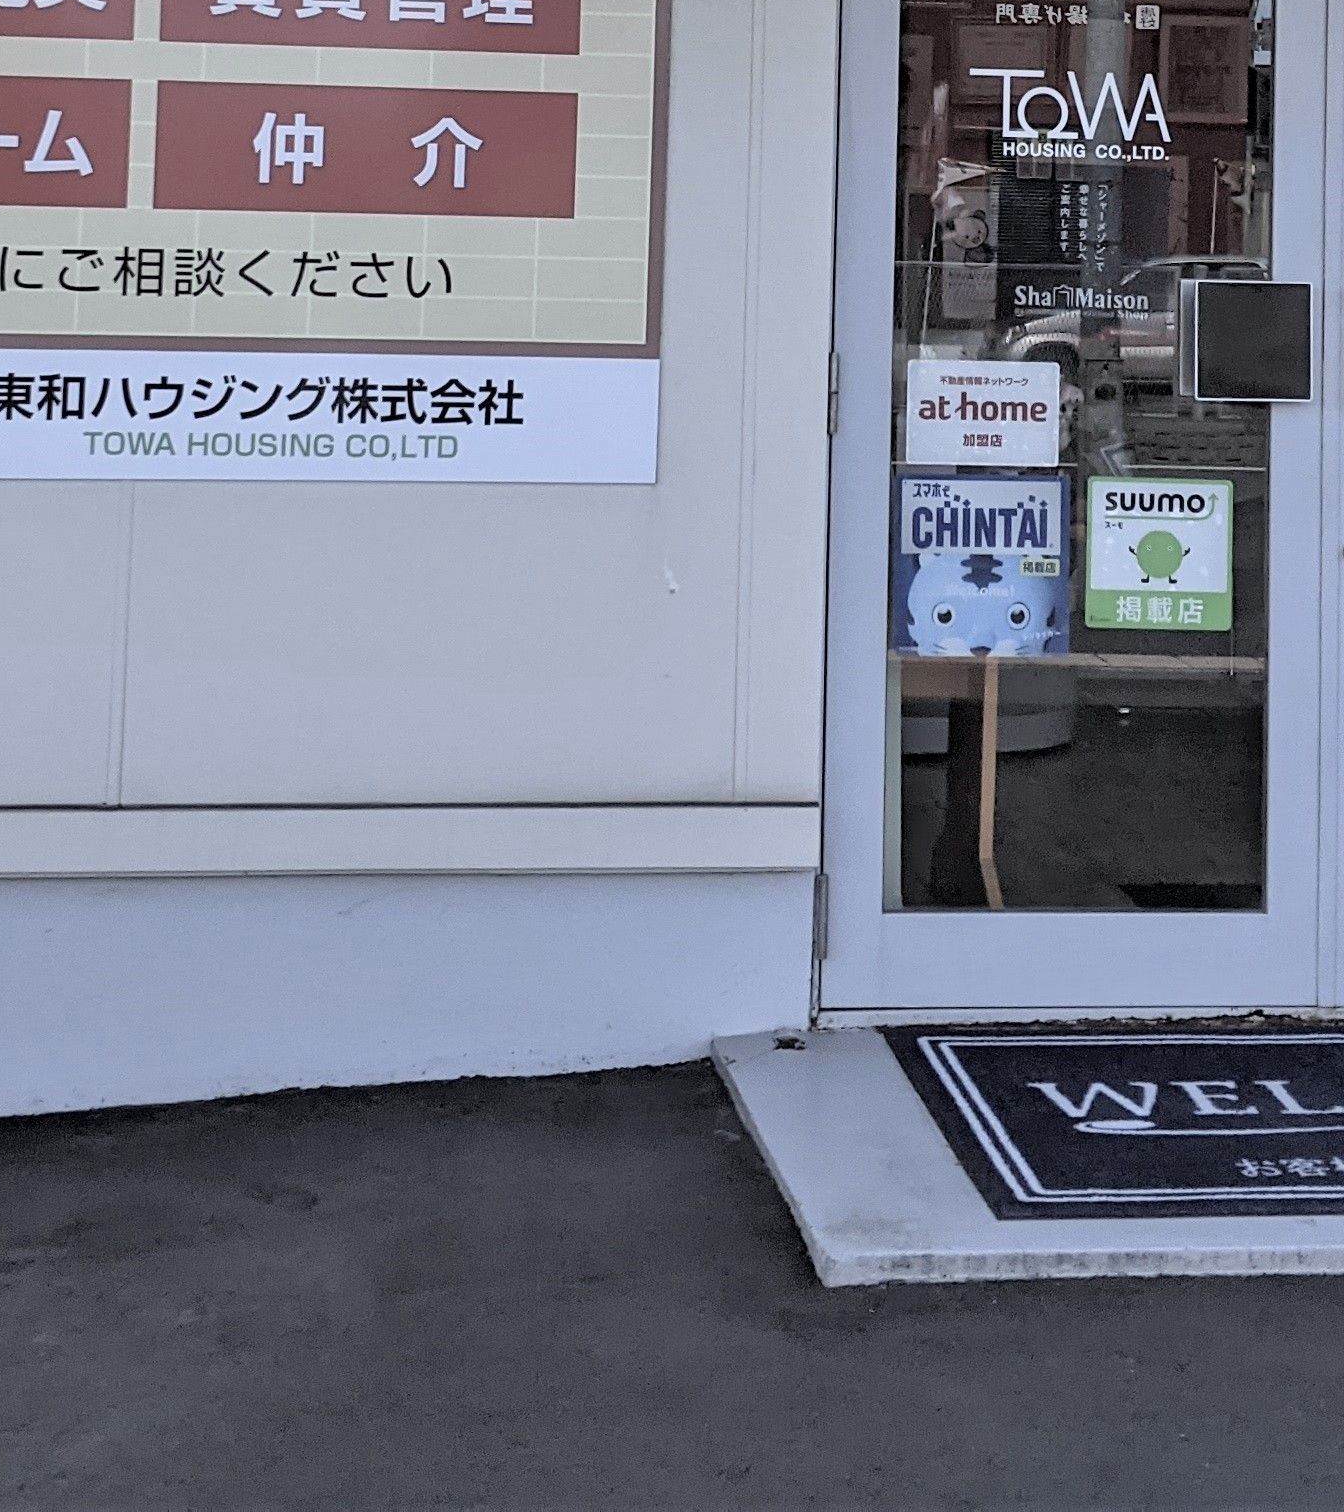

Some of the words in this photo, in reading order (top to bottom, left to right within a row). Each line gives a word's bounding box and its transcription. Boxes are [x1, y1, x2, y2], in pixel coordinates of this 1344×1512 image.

[1003, 142, 1086, 159] HOUSING
[1095, 144, 1170, 163] CO.,LTD.
[918, 395, 951, 421] at
[954, 391, 1048, 423] home
[83, 431, 177, 459] TOWA
[186, 433, 335, 461] HOUSING
[962, 433, 1003, 448] 加盟店
[912, 498, 1048, 549] CHINTAI
[1116, 595, 1204, 624] 掲載店
